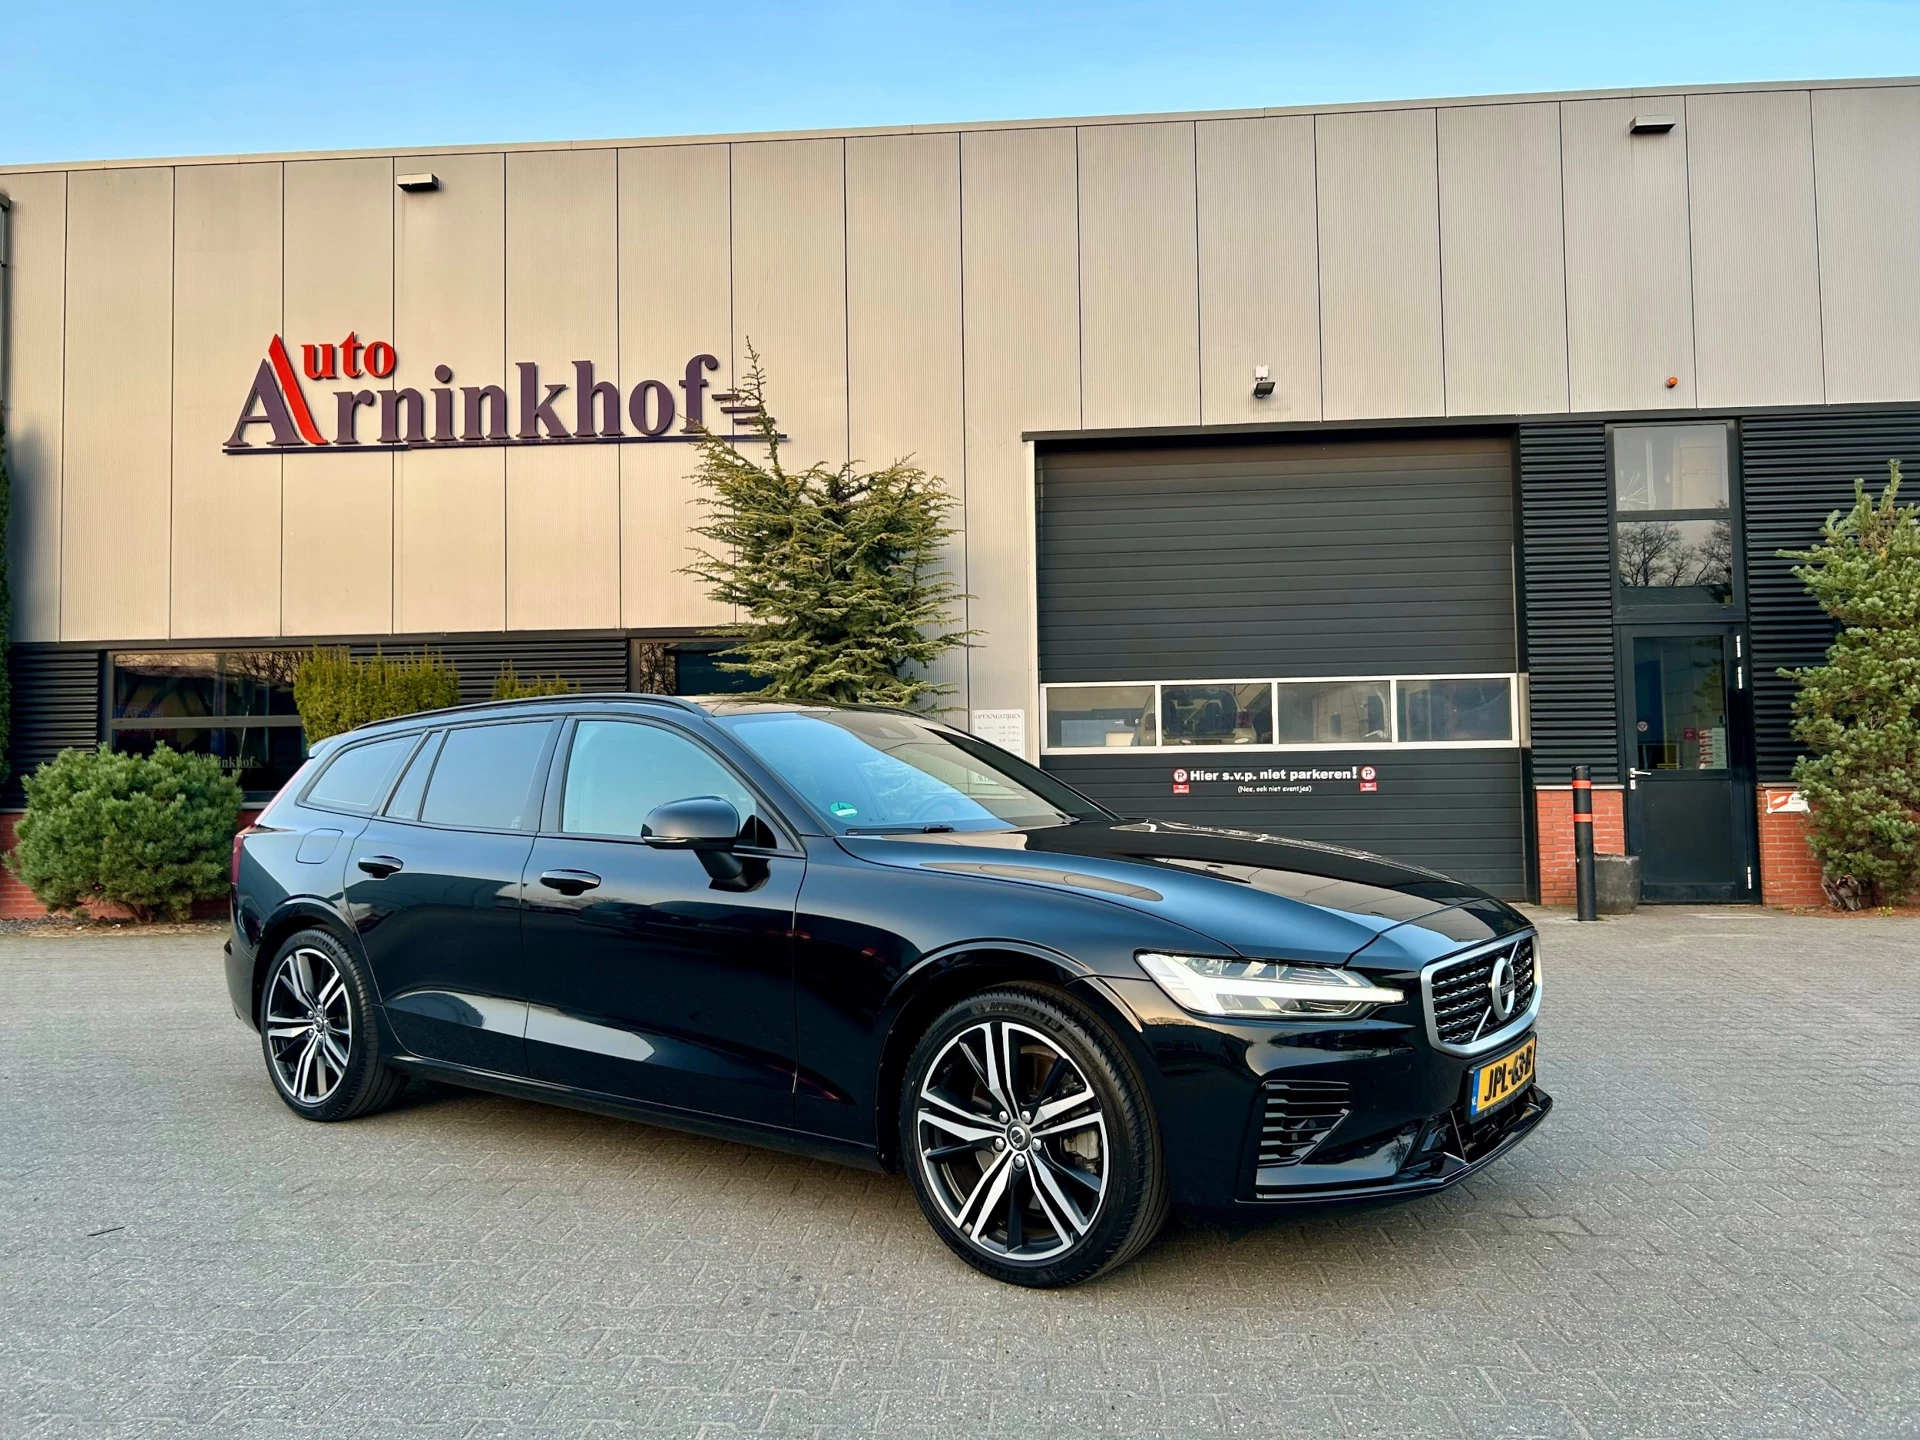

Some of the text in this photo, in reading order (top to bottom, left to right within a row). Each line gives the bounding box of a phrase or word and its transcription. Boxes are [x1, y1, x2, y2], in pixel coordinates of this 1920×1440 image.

[223, 353, 719, 447] Arninkhof
[1190, 766, 1358, 782] Hier s.v.p. niet parkeren!
